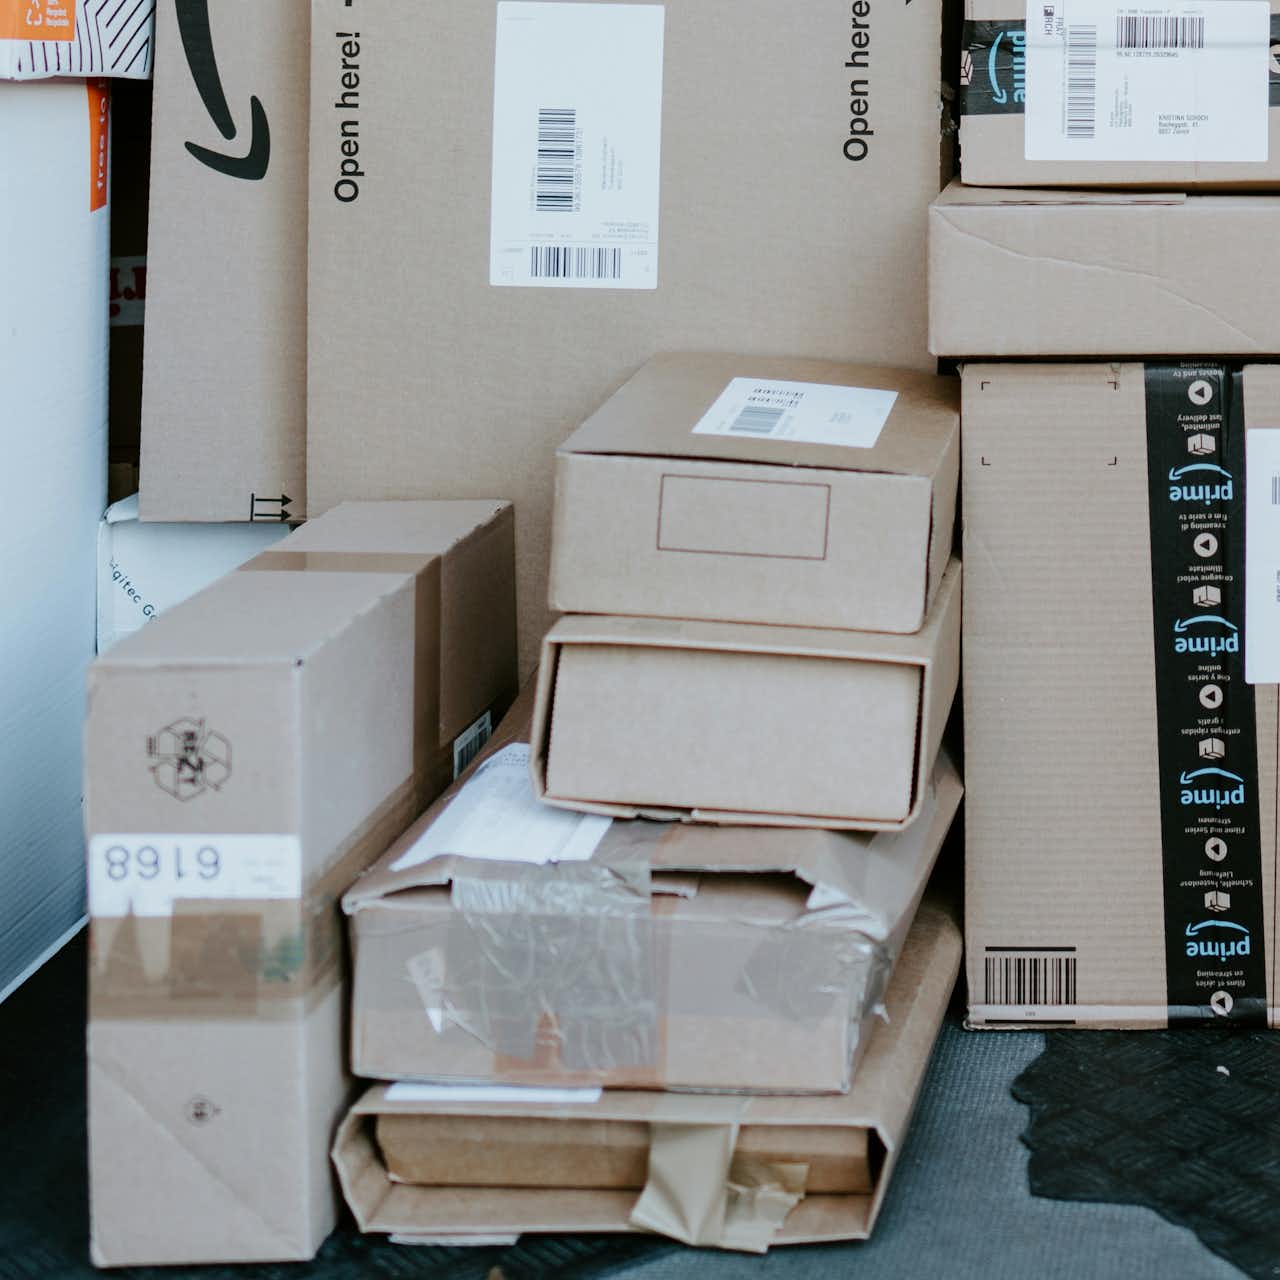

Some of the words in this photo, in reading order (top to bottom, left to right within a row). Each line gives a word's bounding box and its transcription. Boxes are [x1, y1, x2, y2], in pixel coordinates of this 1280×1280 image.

[334, 32, 360, 108] here!
[1006, 30, 1027, 104] prime
[843, 79, 875, 162] Open
[334, 120, 366, 203] Open
[1177, 414, 1207, 423] delivery
[1169, 481, 1233, 505] prime
[1177, 575, 1199, 583] veloci
[1175, 633, 1239, 656] prime
[1198, 665, 1221, 673] online
[1181, 728, 1207, 736] rápidas
[1197, 718, 1220, 727] gratis
[1181, 785, 1245, 809] prime
[1184, 827, 1208, 835] Serien
[1224, 826, 1245, 834] Filme
[103, 843, 222, 882] 6168
[1186, 937, 1250, 960] prime
[1226, 979, 1245, 988] films
